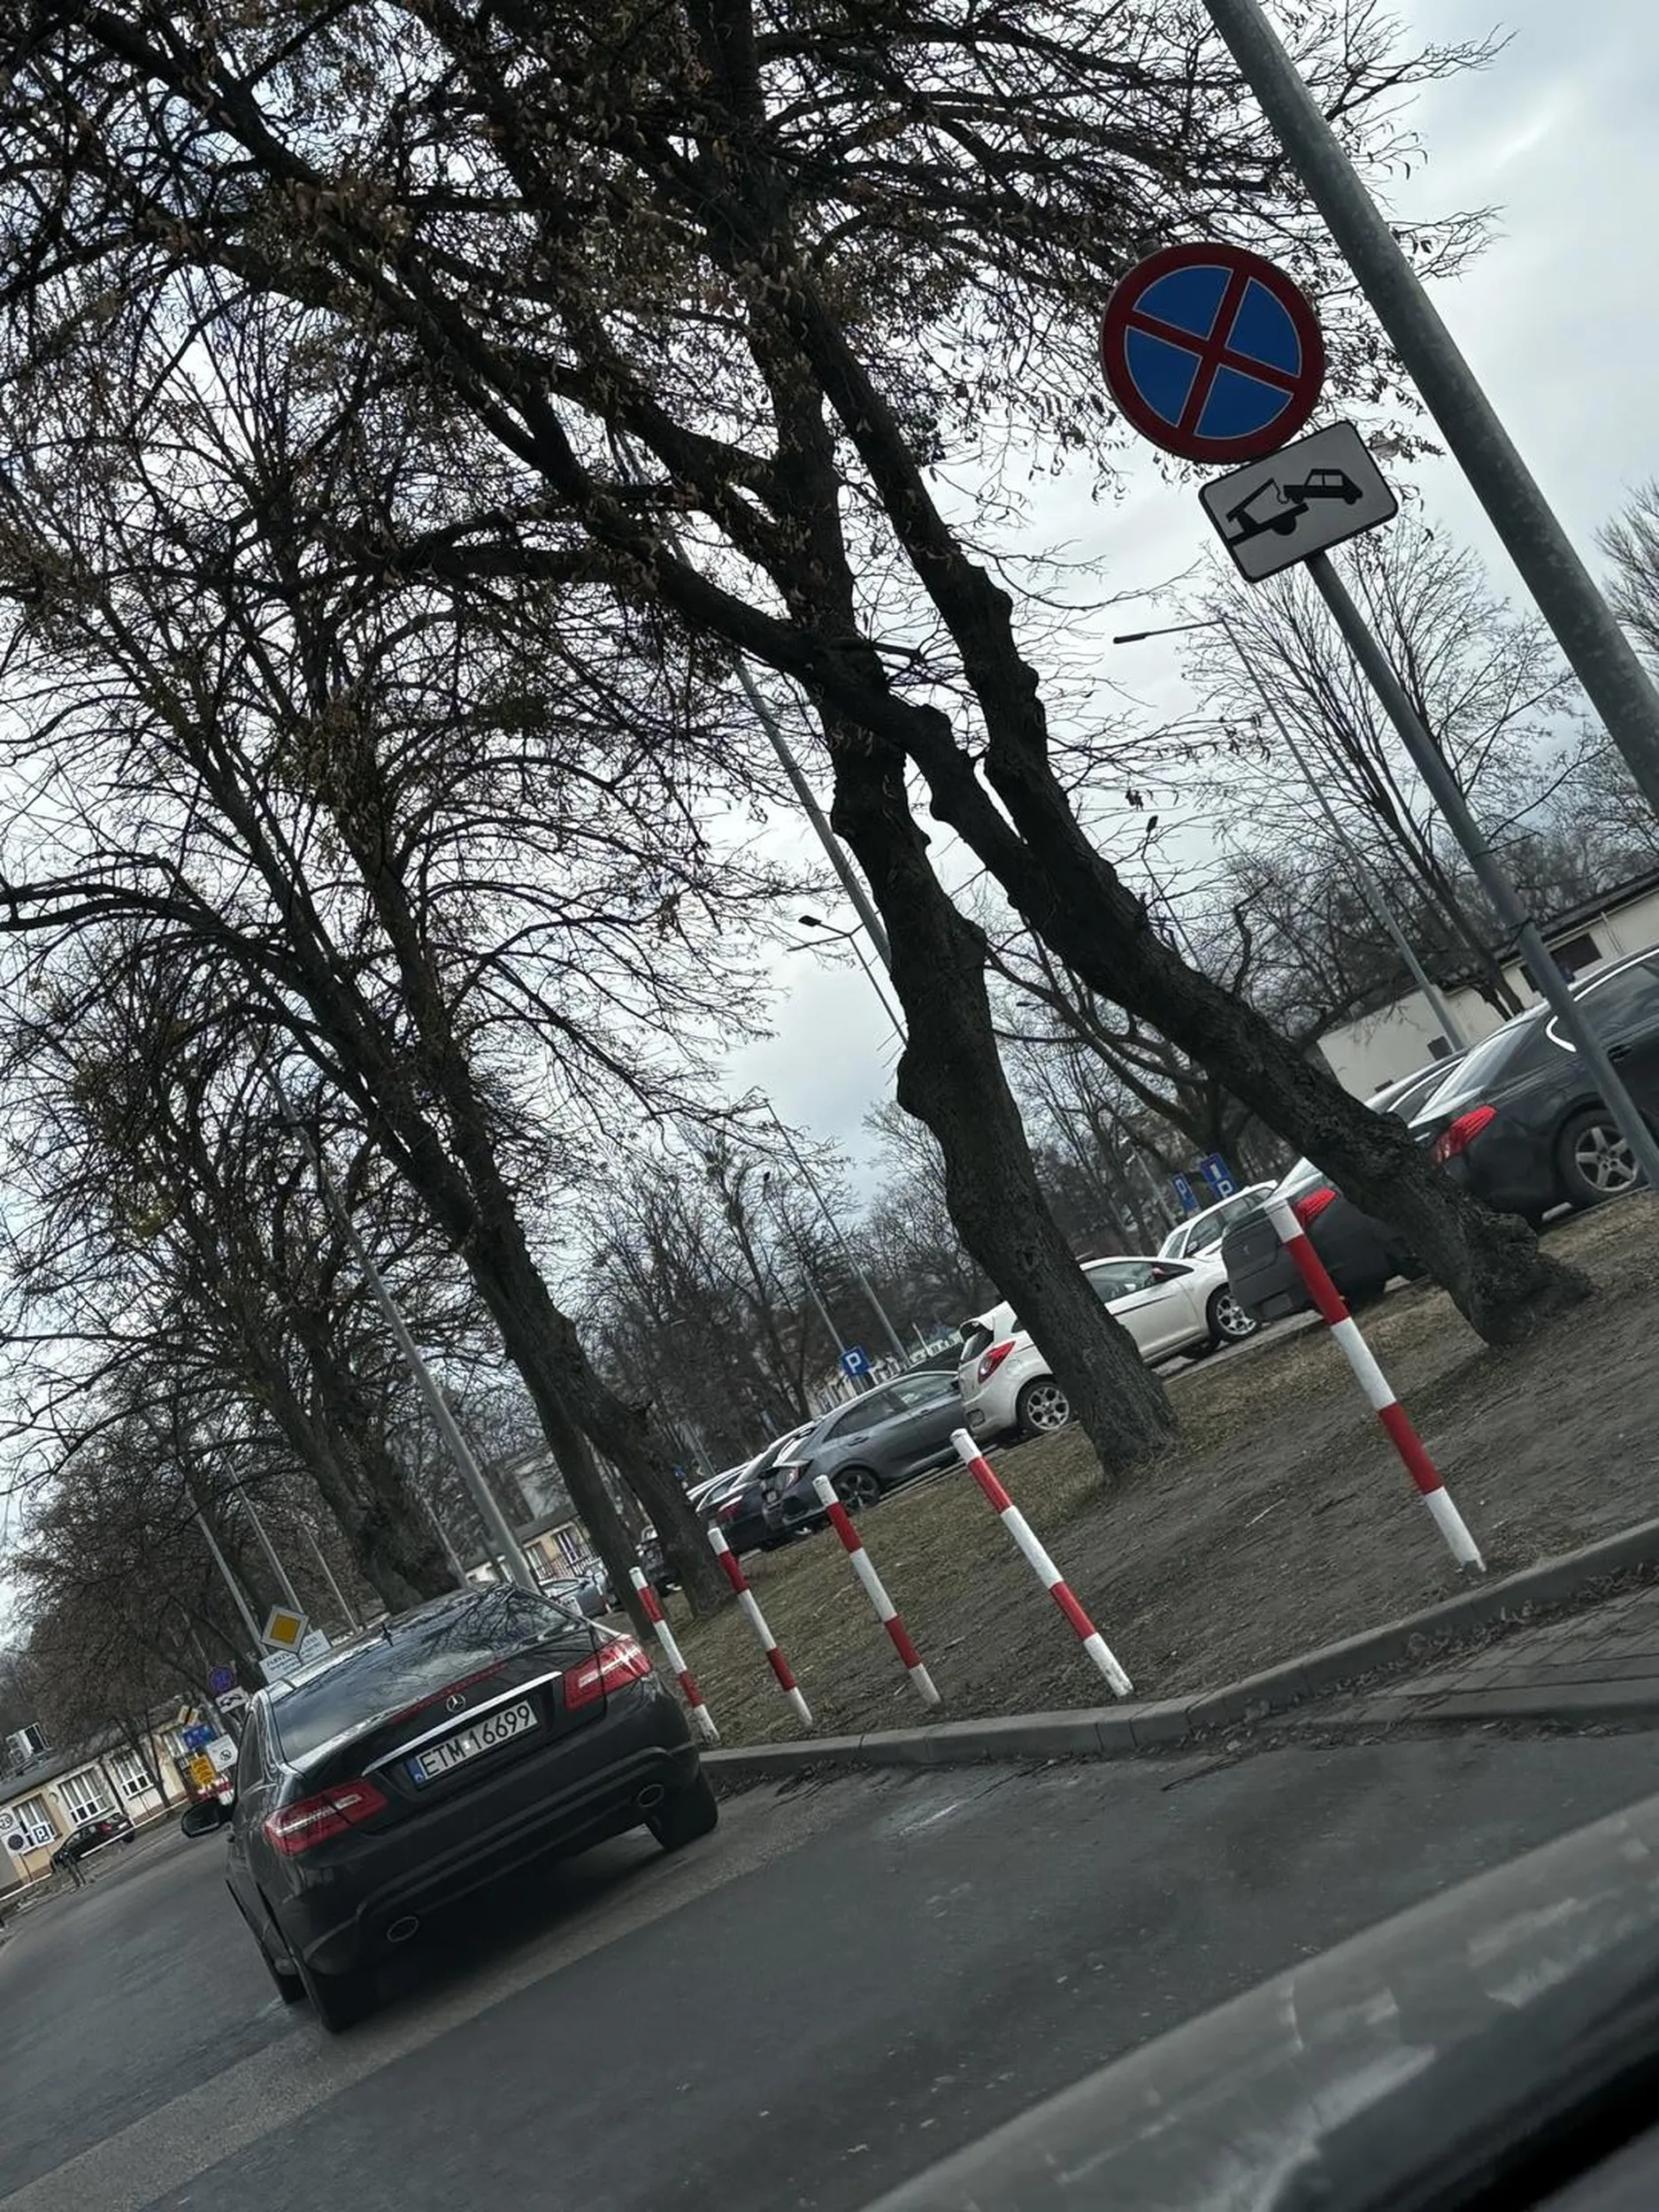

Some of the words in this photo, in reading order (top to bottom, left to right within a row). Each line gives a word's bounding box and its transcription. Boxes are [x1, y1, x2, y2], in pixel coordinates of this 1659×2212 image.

[1217, 1179, 1233, 1198] P
[844, 1352, 862, 1373] P
[420, 1739, 466, 1777] ETM
[468, 1705, 530, 1751] 16699
